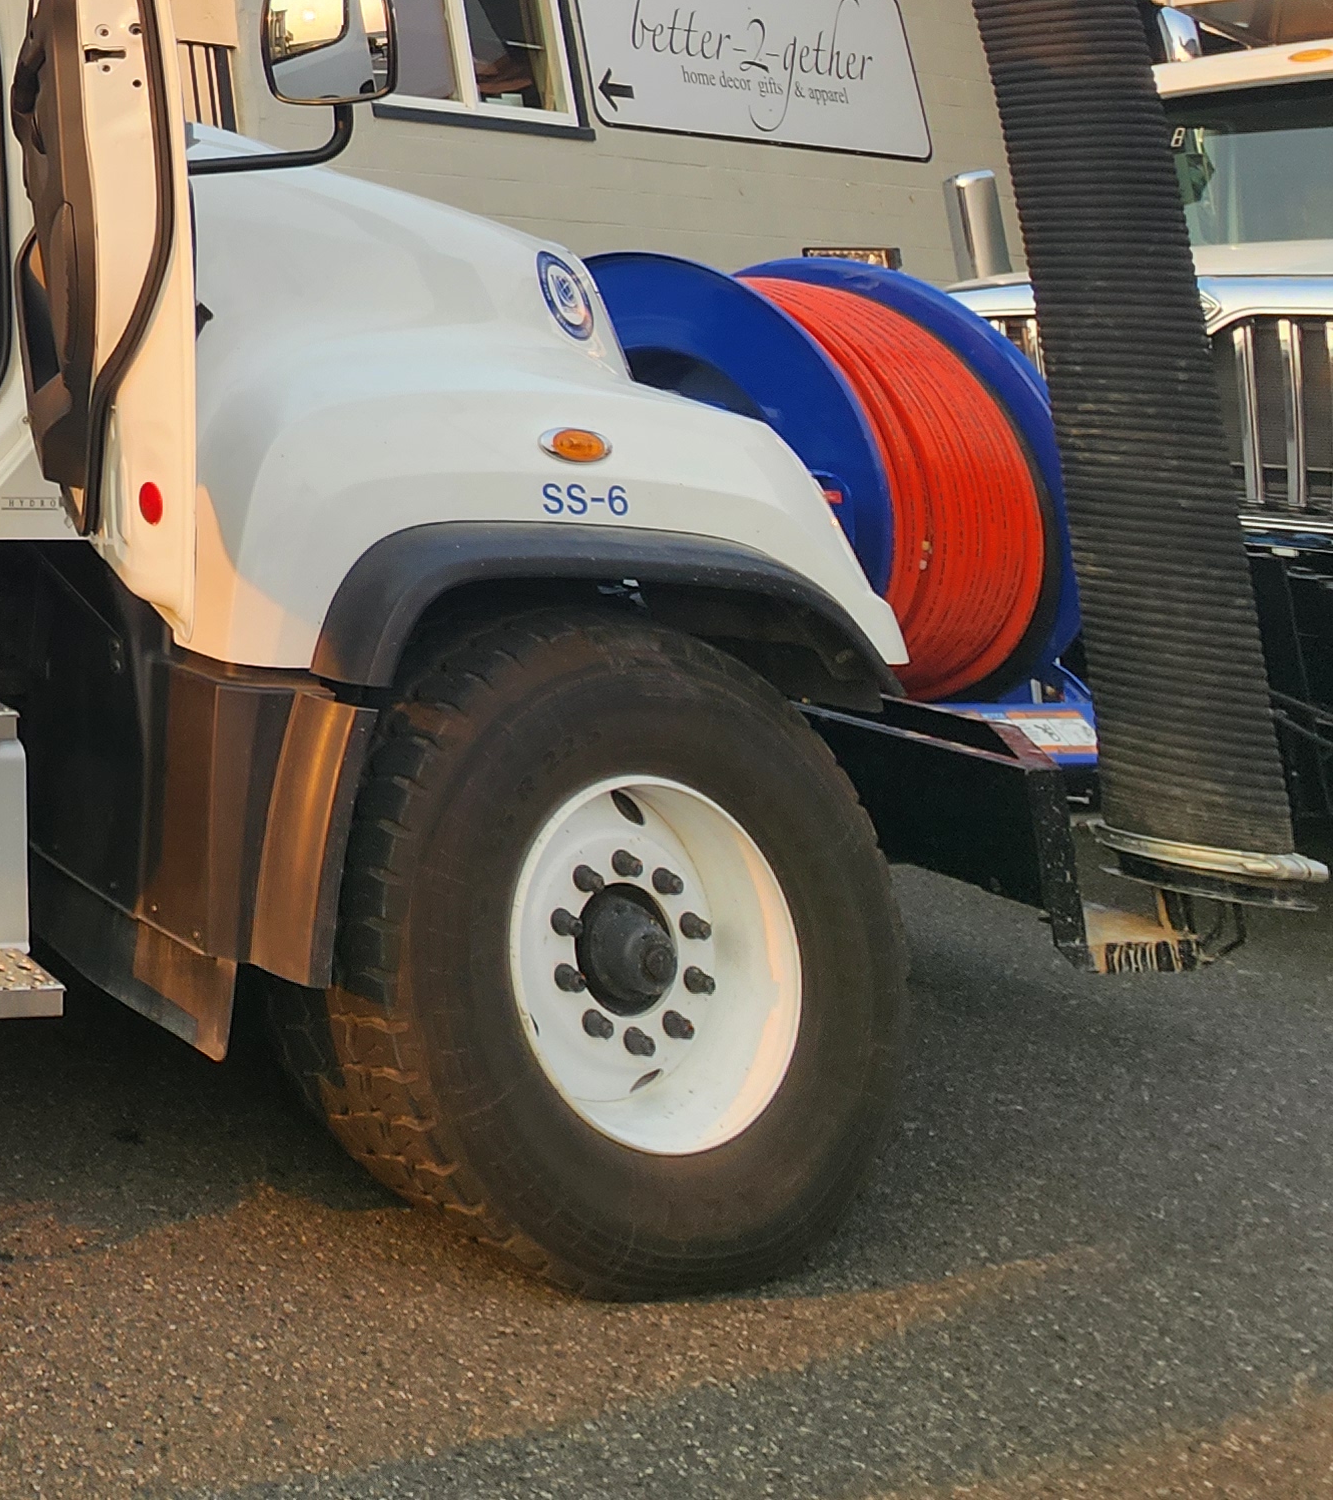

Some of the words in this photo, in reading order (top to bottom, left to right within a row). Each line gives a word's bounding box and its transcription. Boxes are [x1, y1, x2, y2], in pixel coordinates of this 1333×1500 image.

[681, 65, 716, 87] home
[719, 72, 752, 92] decor
[758, 77, 784, 98] gifts
[794, 81, 806, 98] &
[809, 87, 850, 105] apparel
[542, 483, 629, 516] SS-6
